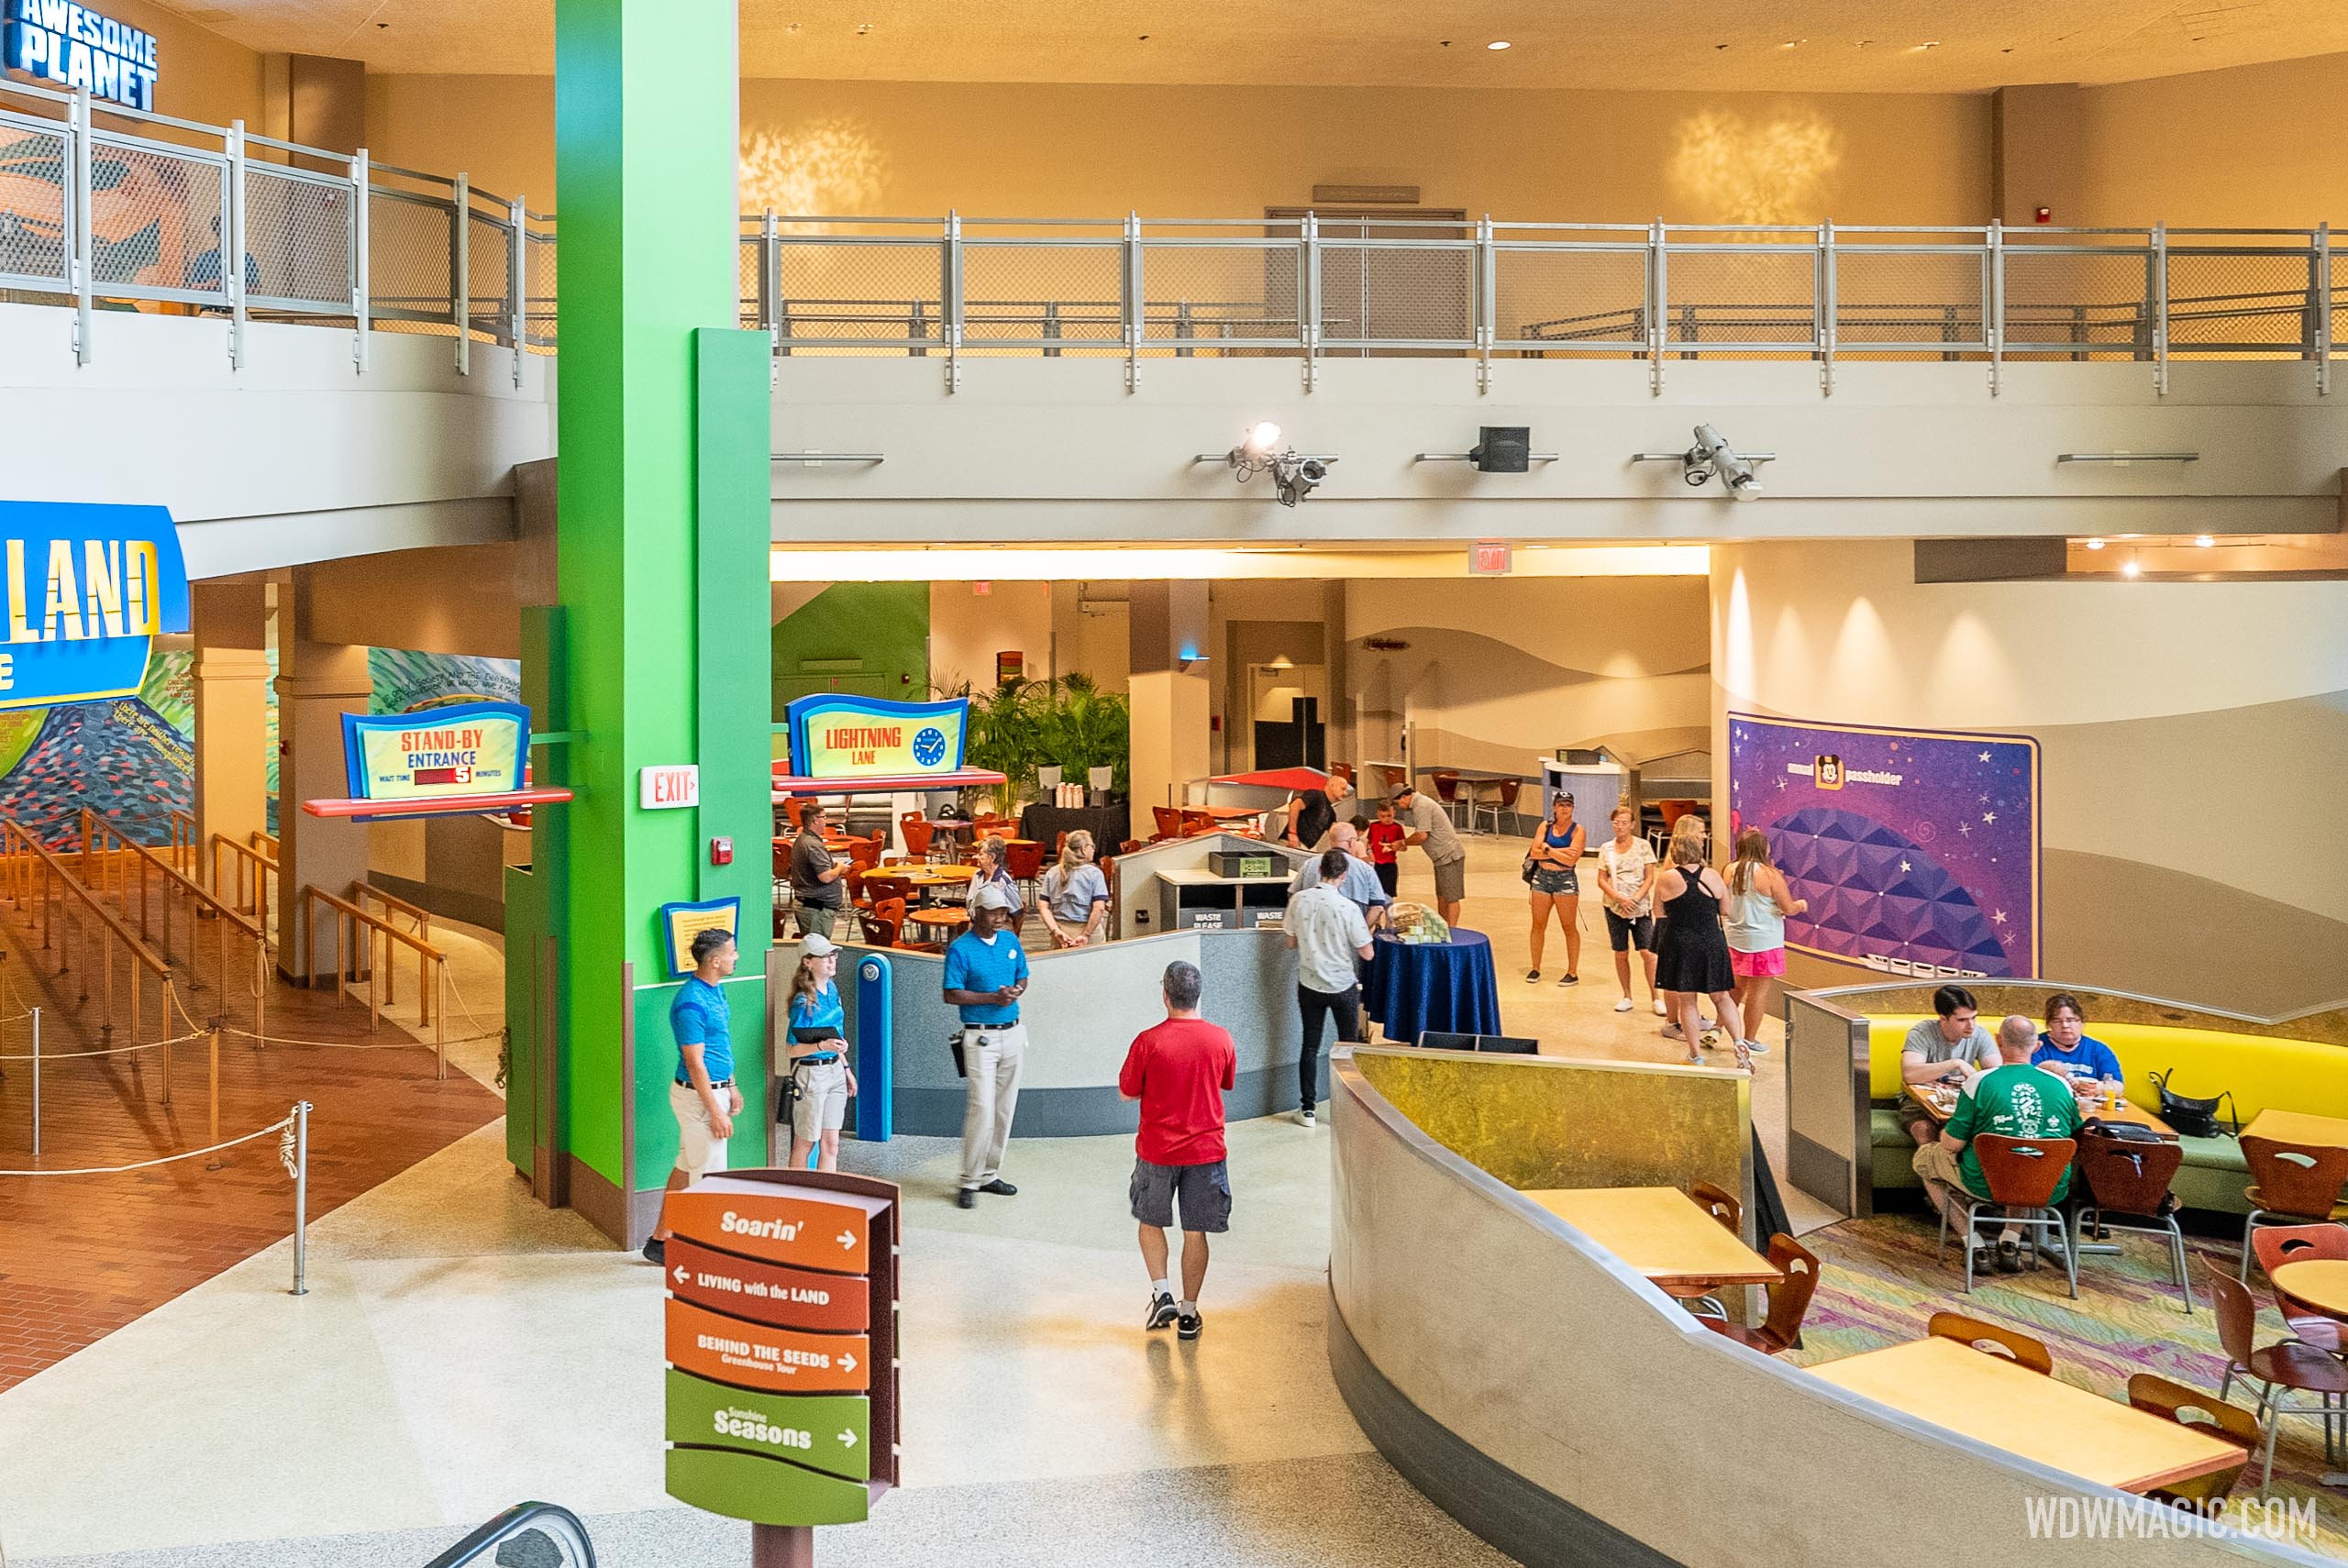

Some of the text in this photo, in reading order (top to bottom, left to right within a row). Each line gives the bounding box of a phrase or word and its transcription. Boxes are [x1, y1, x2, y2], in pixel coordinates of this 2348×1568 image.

[20, 0, 159, 69] AWESOME
[20, 22, 159, 112] PLANET
[6, 539, 161, 642] LAND
[468, 670, 481, 679] THE
[401, 729, 483, 752] STAND-BY
[826, 727, 902, 749] LIGHTNING
[408, 751, 476, 768] ENTRANCE
[851, 751, 876, 765] LANE
[455, 767, 470, 782] 5
[1844, 770, 1902, 786] passholder
[655, 771, 691, 802] EXIT
[1195, 913, 1222, 922] WASTE
[1257, 911, 1283, 920] WASTE
[720, 1210, 804, 1242] Soarin'
[697, 1272, 830, 1306] LIVING with the LAND
[697, 1334, 830, 1369] BEHIND THE SEEDS
[721, 1353, 797, 1375] Greenhouse Tour
[728, 1406, 768, 1423] Sunshine
[714, 1409, 813, 1450] Seasons
